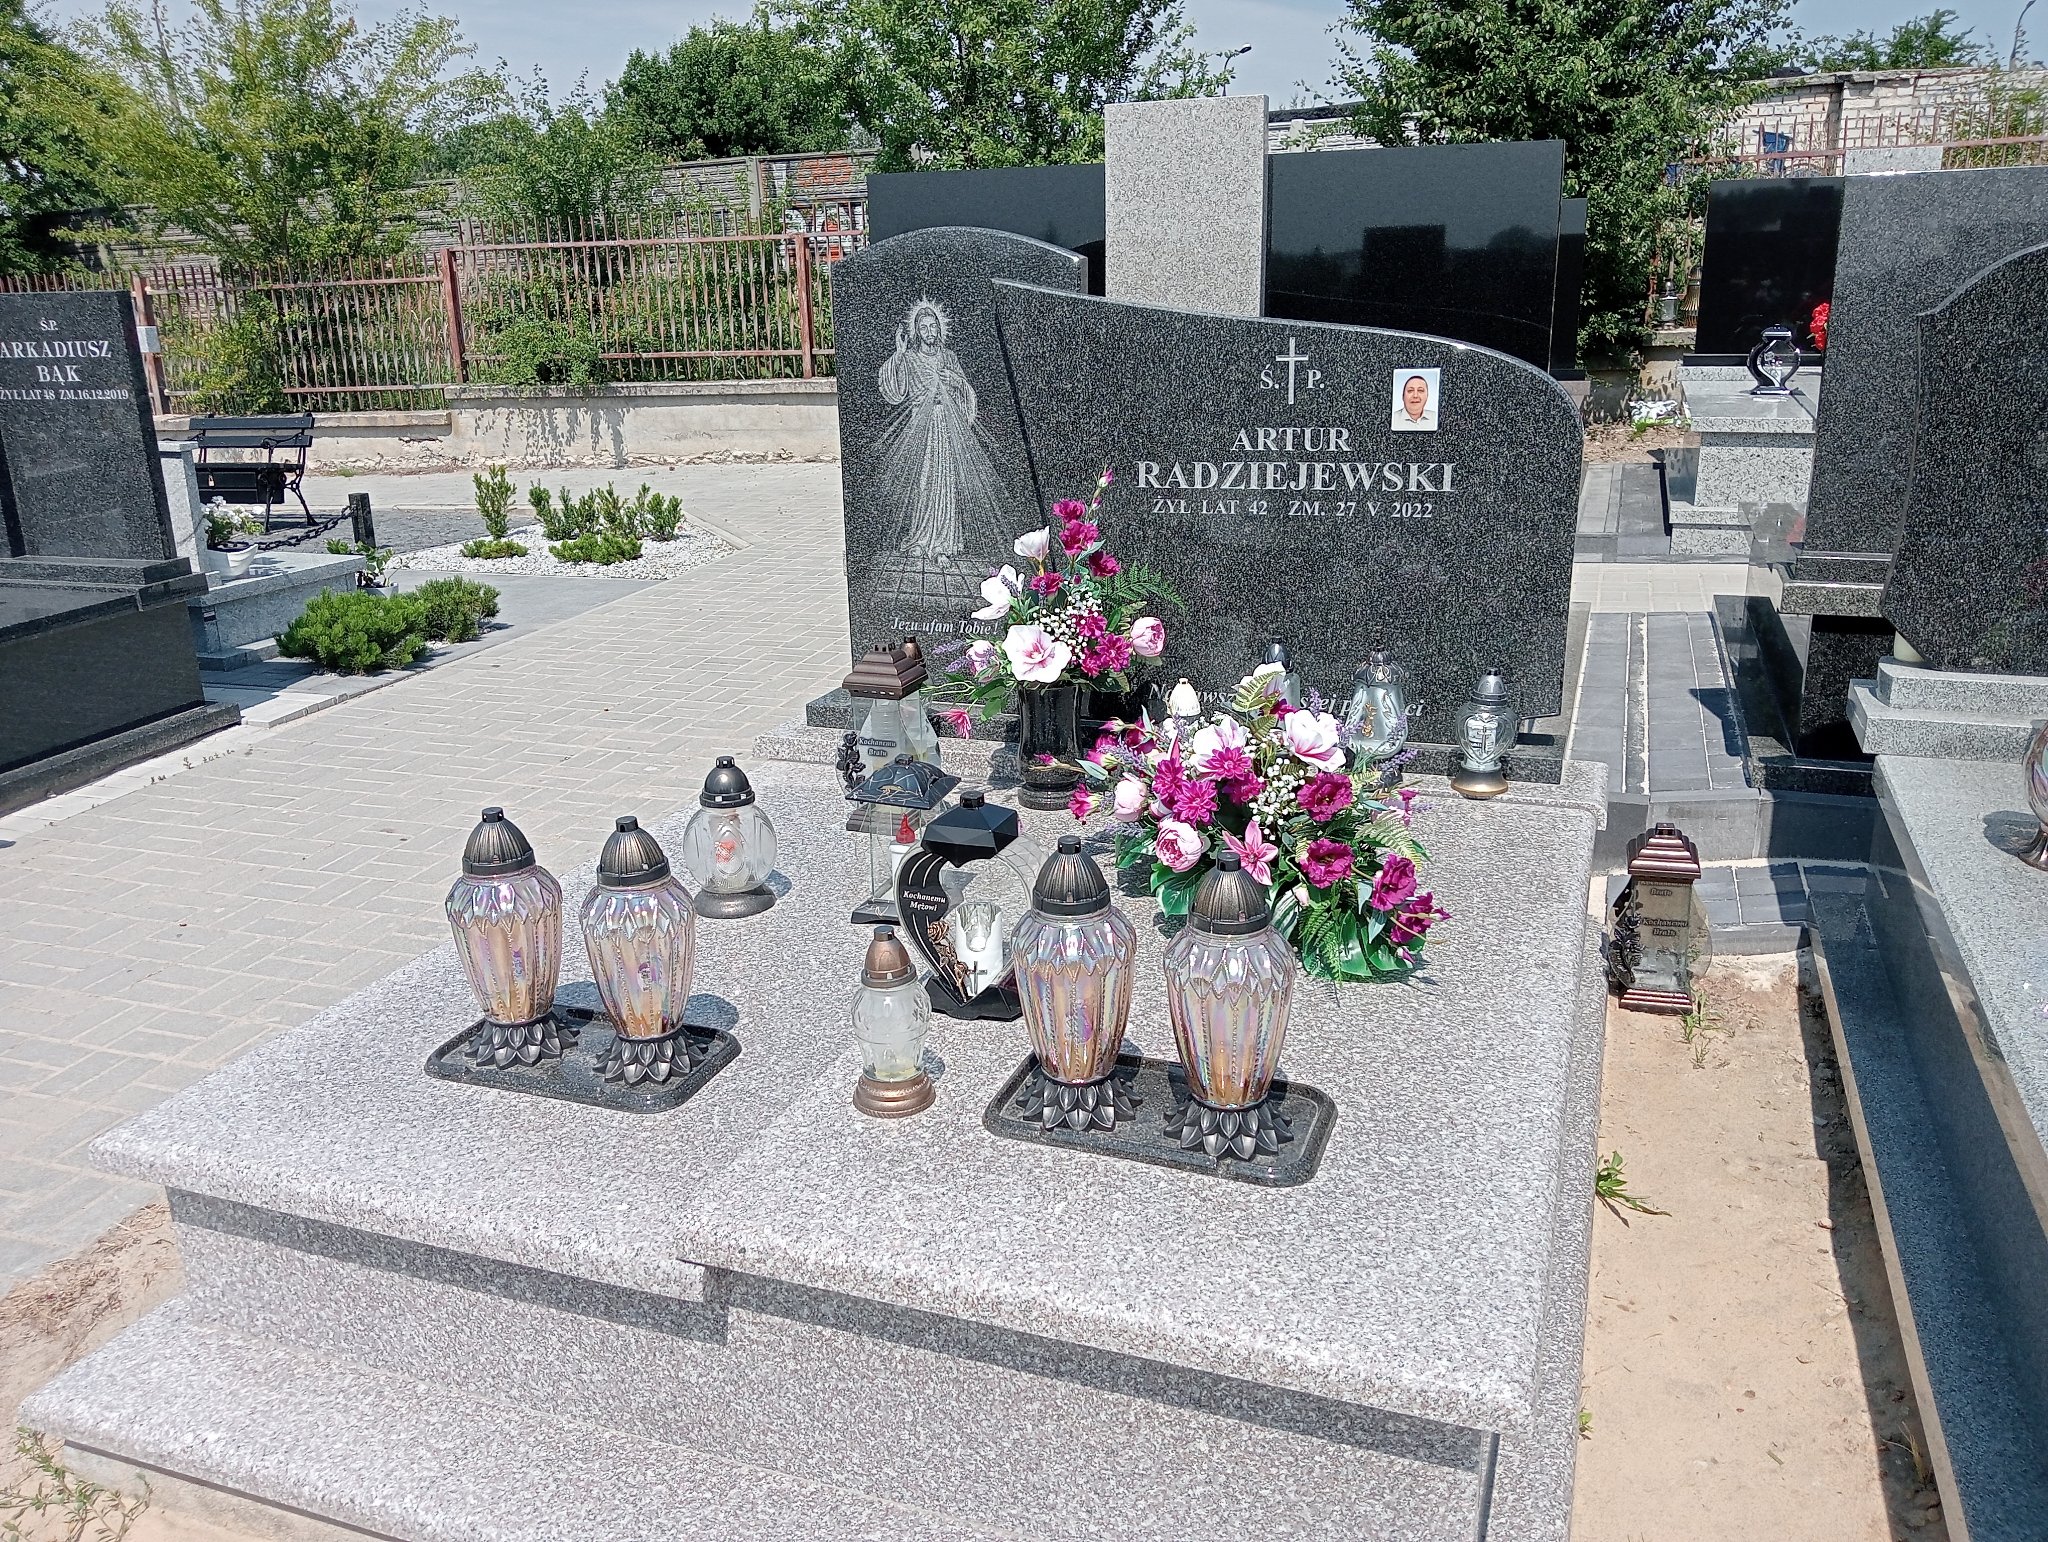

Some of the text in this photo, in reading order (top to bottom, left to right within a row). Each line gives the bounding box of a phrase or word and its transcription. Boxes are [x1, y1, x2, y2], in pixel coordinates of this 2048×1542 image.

[0, 340, 112, 358] ARKADIUSZ
[36, 365, 82, 385] BĄK
[1260, 364, 1325, 389] Ś. P.
[21, 389, 42, 400] LAT
[1231, 427, 1351, 451] ARTUR
[1136, 460, 1456, 492] RADZIEJEWSKI
[1152, 495, 1433, 518] ŻYŁ LAT 42 ZM. 27 V 2022
[891, 618, 919, 632] Jezu
[922, 618, 955, 635] ufam
[903, 890, 946, 904] Kochanemu
[910, 901, 938, 912] Mężowi
